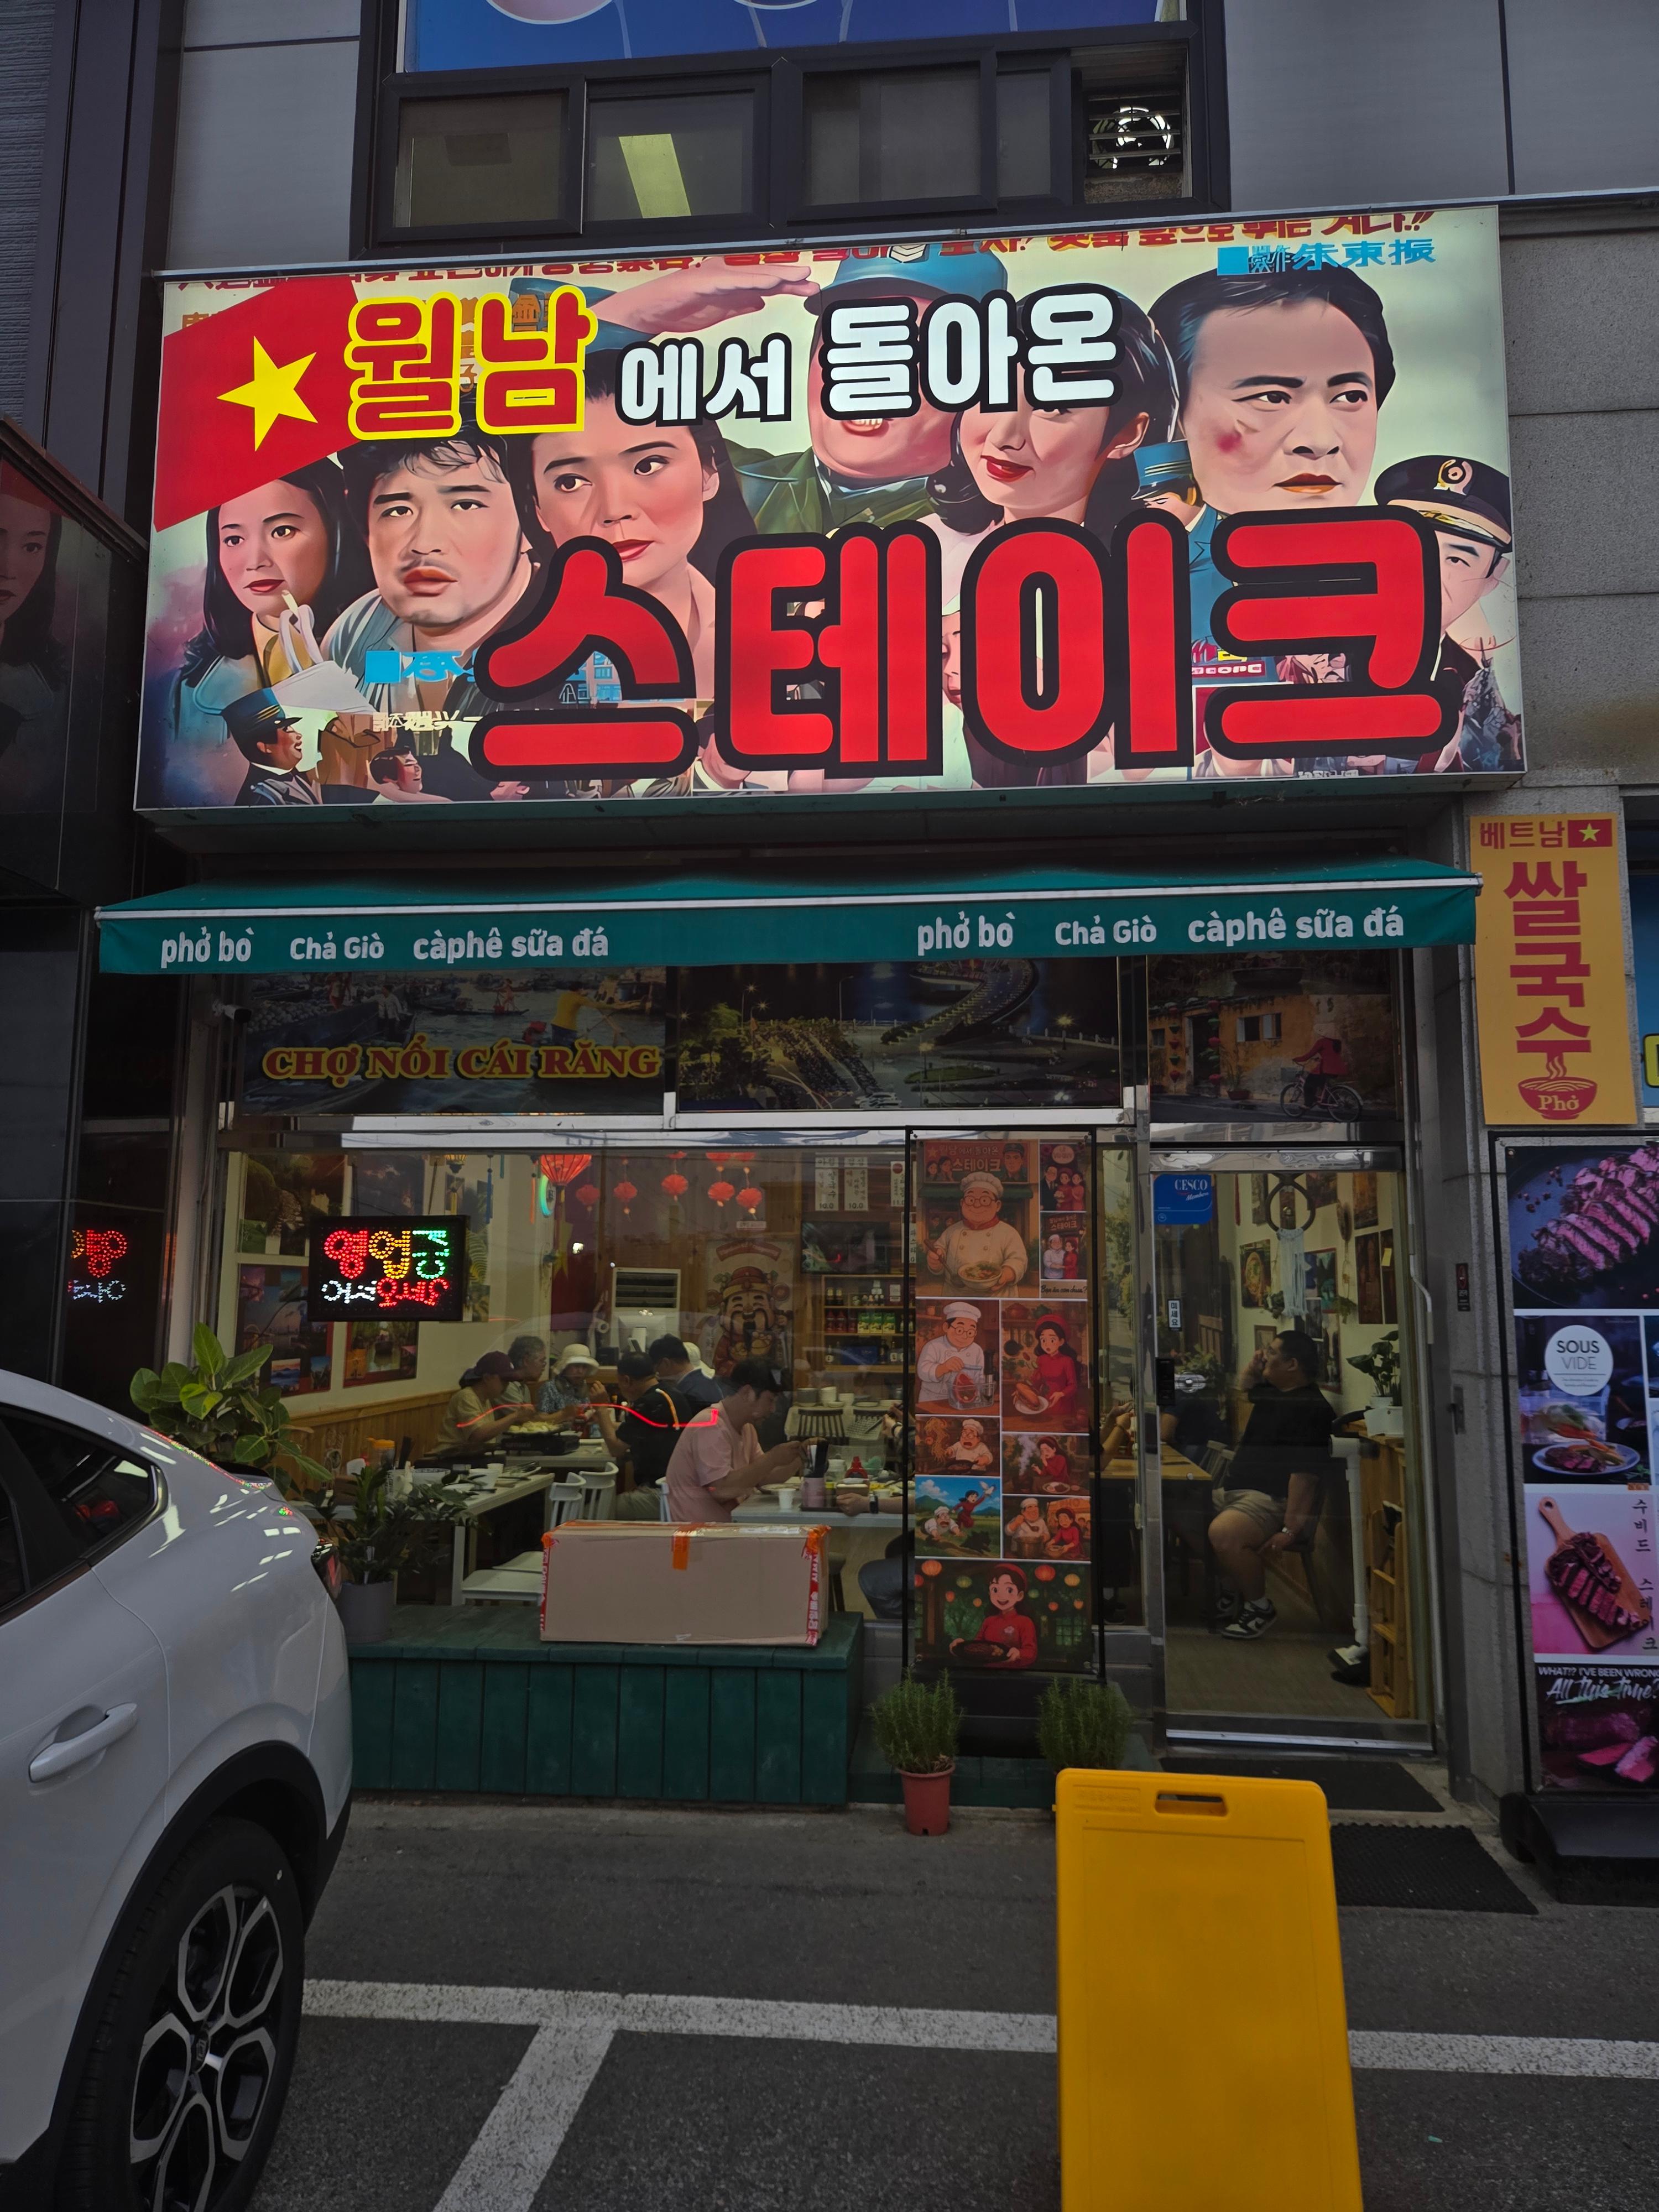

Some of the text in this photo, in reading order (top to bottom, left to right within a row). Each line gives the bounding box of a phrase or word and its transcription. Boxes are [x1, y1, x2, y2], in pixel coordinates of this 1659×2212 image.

[344, 284, 598, 441] 월남
[819, 283, 1126, 420] 돌아온
[468, 504, 1460, 776] 스테이크
[1480, 821, 1565, 849] 베트남
[917, 909, 1015, 956] phở bò
[1055, 915, 1157, 946] Chả Giò
[1188, 905, 1404, 947] càphê sữa đá
[160, 926, 254, 968] phở bò
[290, 931, 384, 960] Chả Giò
[413, 926, 609, 963] càphê sữa đá
[1504, 860, 1591, 1070] 쌀국수
[262, 1033, 662, 1088] CHỢ NỔI CÁI RĂNG
[952, 1157, 1001, 1172] 스테이크
[1175, 1178, 1208, 1190] CESCO
[1050, 1220, 1078, 1231] 스테이크
[324, 1229, 449, 1279] 영업중
[1556, 1340, 1600, 1353] SOUS
[1561, 1357, 1597, 1370] VIDE
[1632, 1499, 1651, 1552] 수비드
[1545, 1677, 1575, 1701] All
[1598, 1668, 1623, 1677] BEEN
